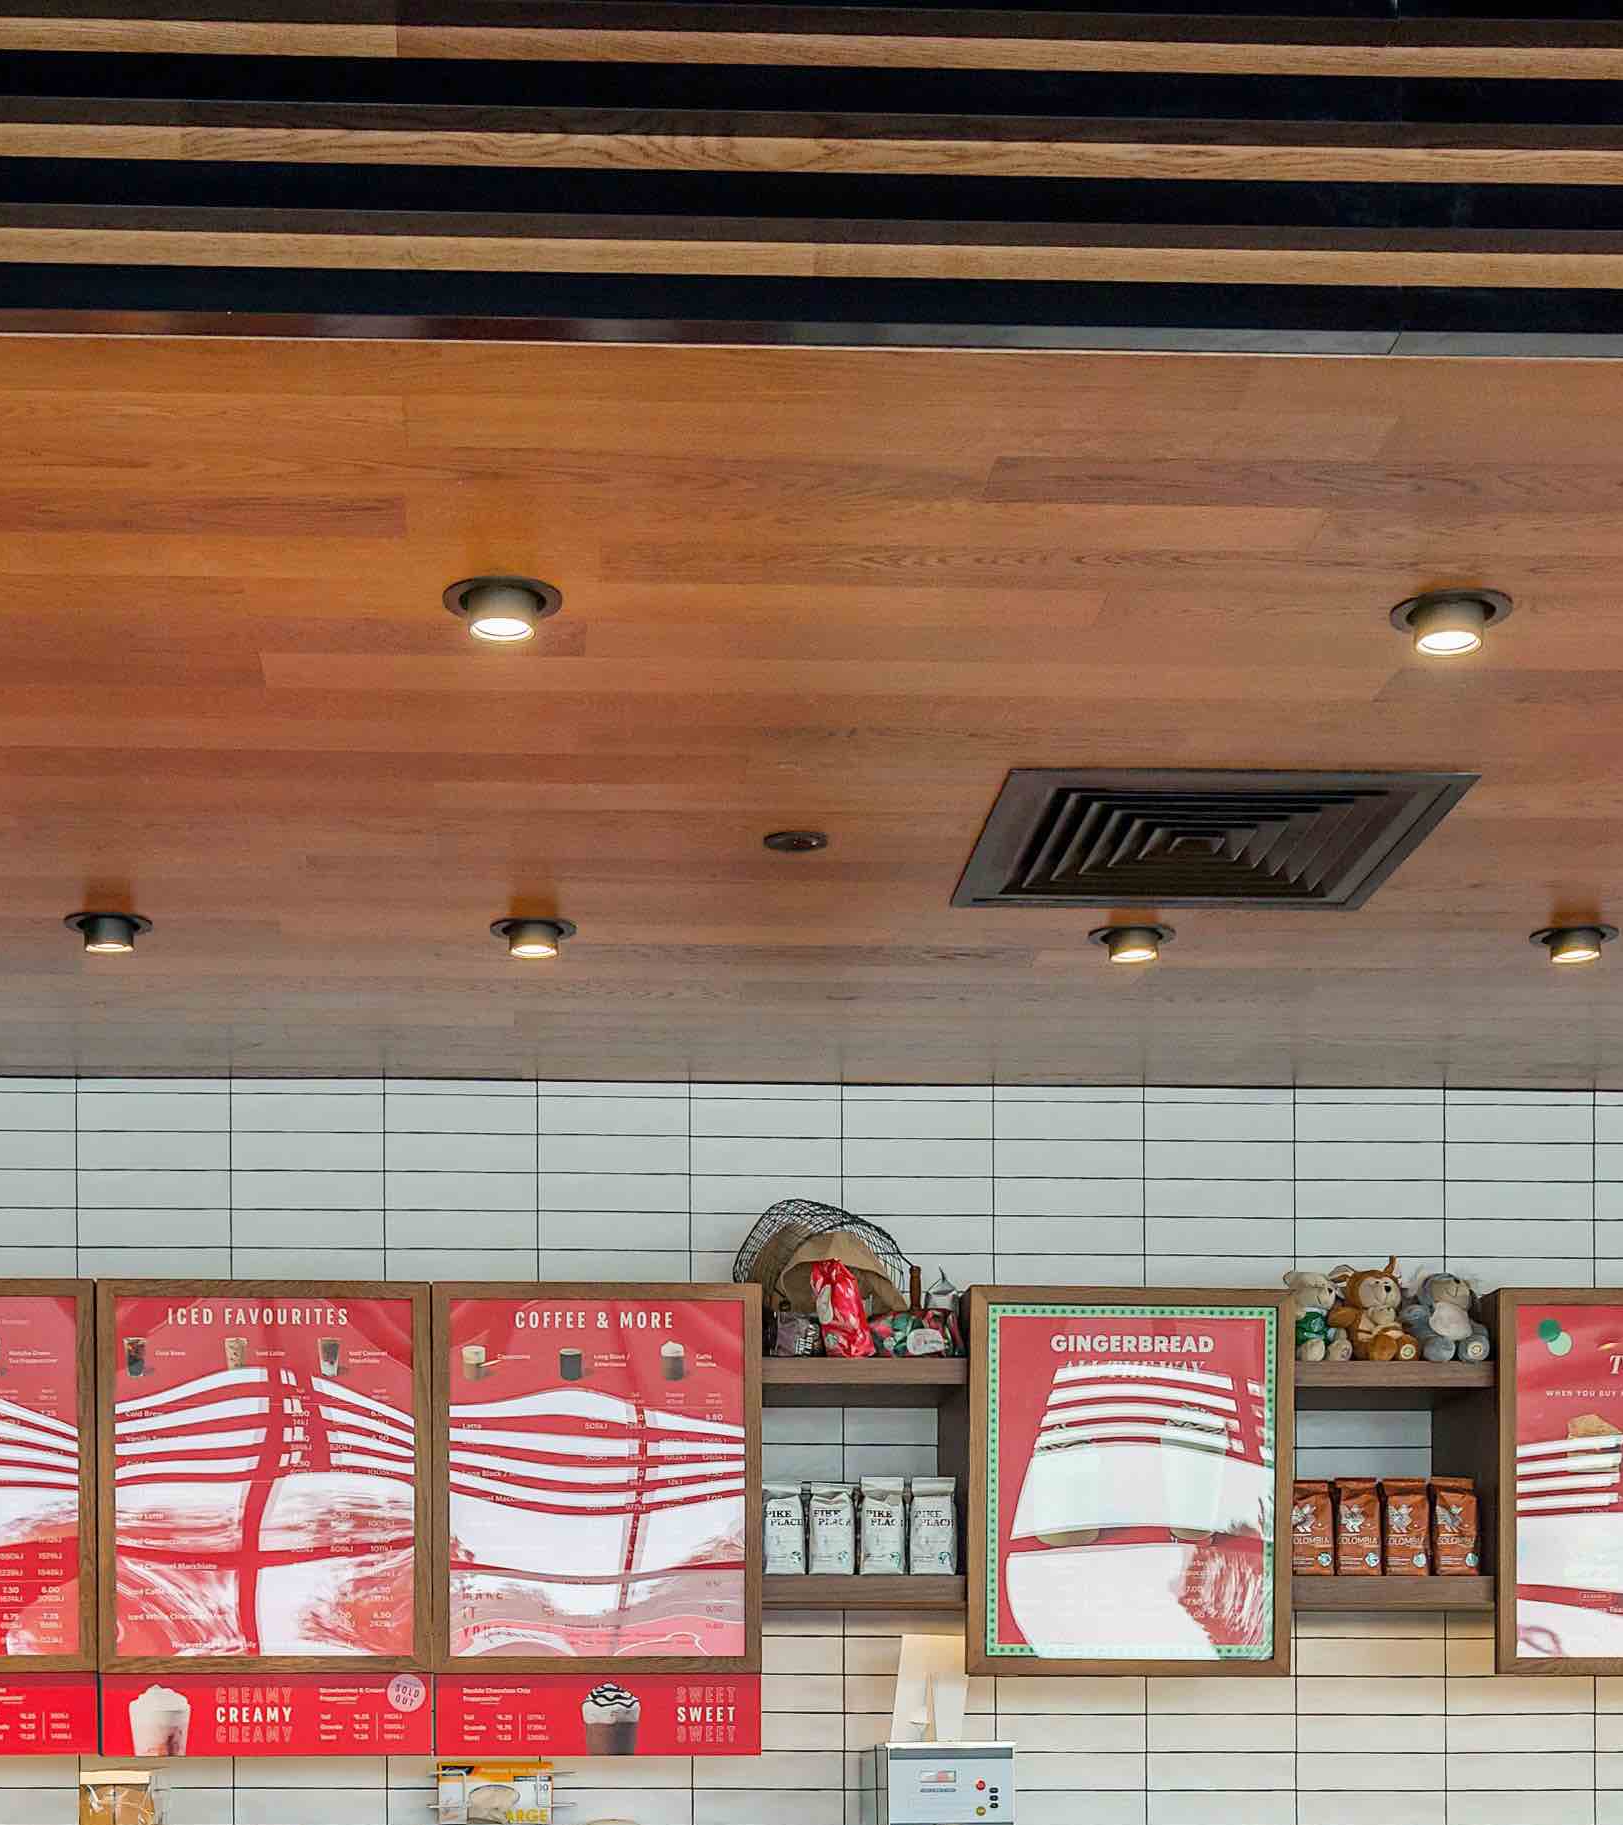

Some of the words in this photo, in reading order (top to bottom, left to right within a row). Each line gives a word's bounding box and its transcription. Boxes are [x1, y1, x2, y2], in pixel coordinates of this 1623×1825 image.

[168, 1308, 213, 1325] ICED
[225, 1307, 348, 1325] FAVOURITES
[515, 1311, 586, 1329] COFFEE
[597, 1311, 610, 1328] &
[620, 1311, 674, 1329] MORE
[1050, 1335, 1215, 1353] GINGERBREAD
[1577, 1389, 1595, 1397] YOU
[215, 1686, 292, 1704] CREAMY
[394, 1683, 420, 1698] SOLD
[677, 1686, 736, 1704] SWEET
[394, 1695, 414, 1707] OUT
[215, 1706, 292, 1723] CREAMY
[677, 1707, 736, 1723] SWEET
[215, 1726, 292, 1743] CREAMY
[677, 1725, 736, 1743] SWEET
